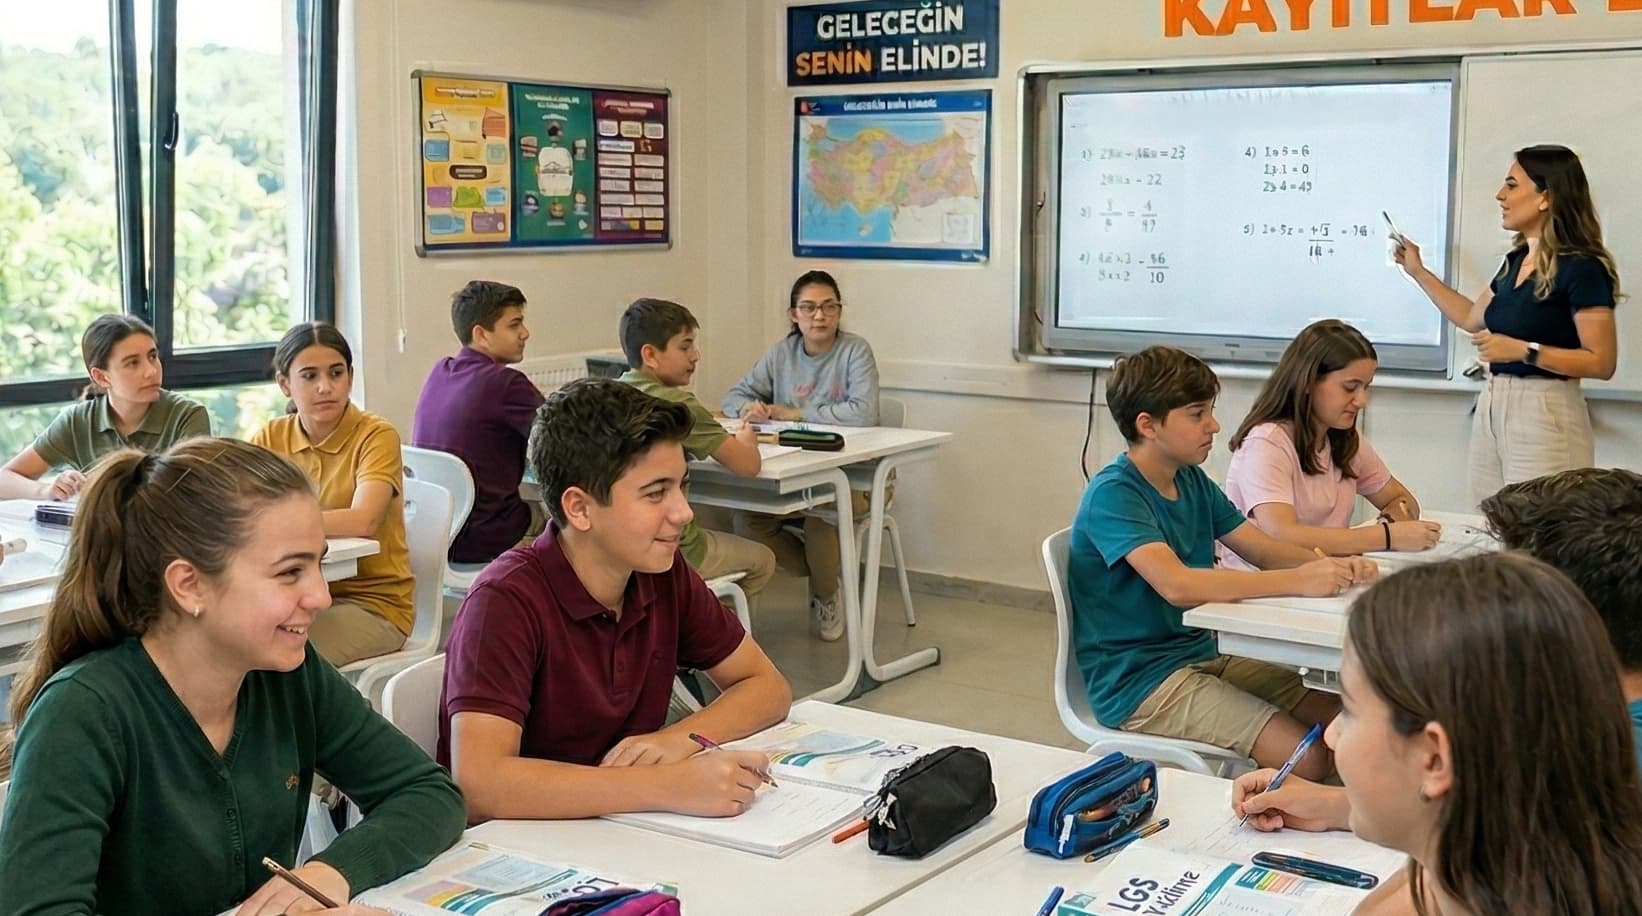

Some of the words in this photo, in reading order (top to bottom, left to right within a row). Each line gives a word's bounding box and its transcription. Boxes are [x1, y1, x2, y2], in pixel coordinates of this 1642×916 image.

[816, 1, 964, 40] GELECEĞİN
[795, 43, 873, 77] SENİN
[881, 39, 987, 73] ELİNDE!
[1107, 877, 1159, 911] LGS
